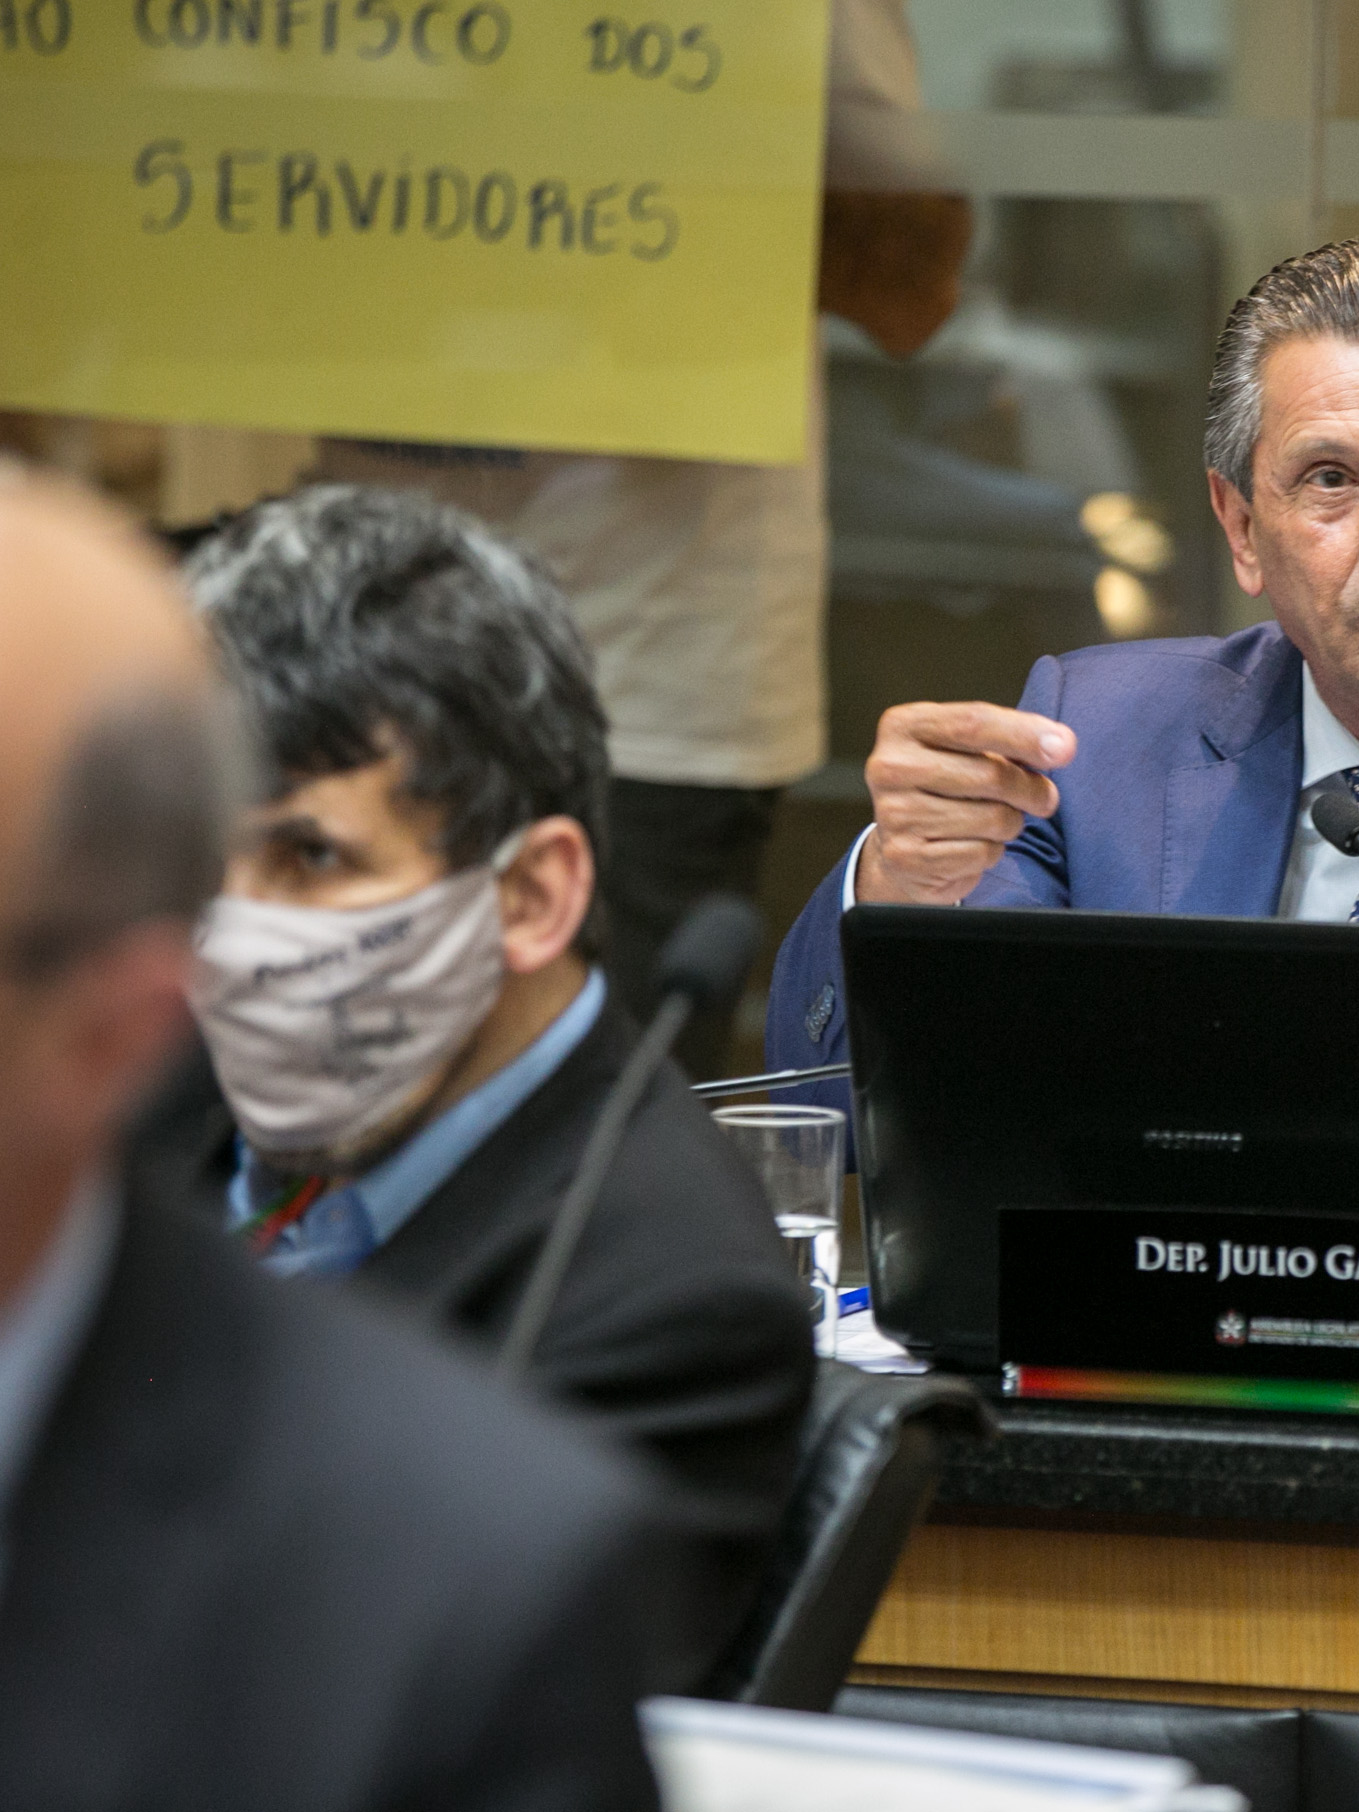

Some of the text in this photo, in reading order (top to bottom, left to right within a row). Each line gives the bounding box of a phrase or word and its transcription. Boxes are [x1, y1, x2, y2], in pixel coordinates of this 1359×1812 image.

[133, 0, 512, 66] CONFISCO
[584, 14, 724, 93] DOS
[132, 136, 681, 263] SERVIDORES
[1216, 1239, 1318, 1282] JULIO
